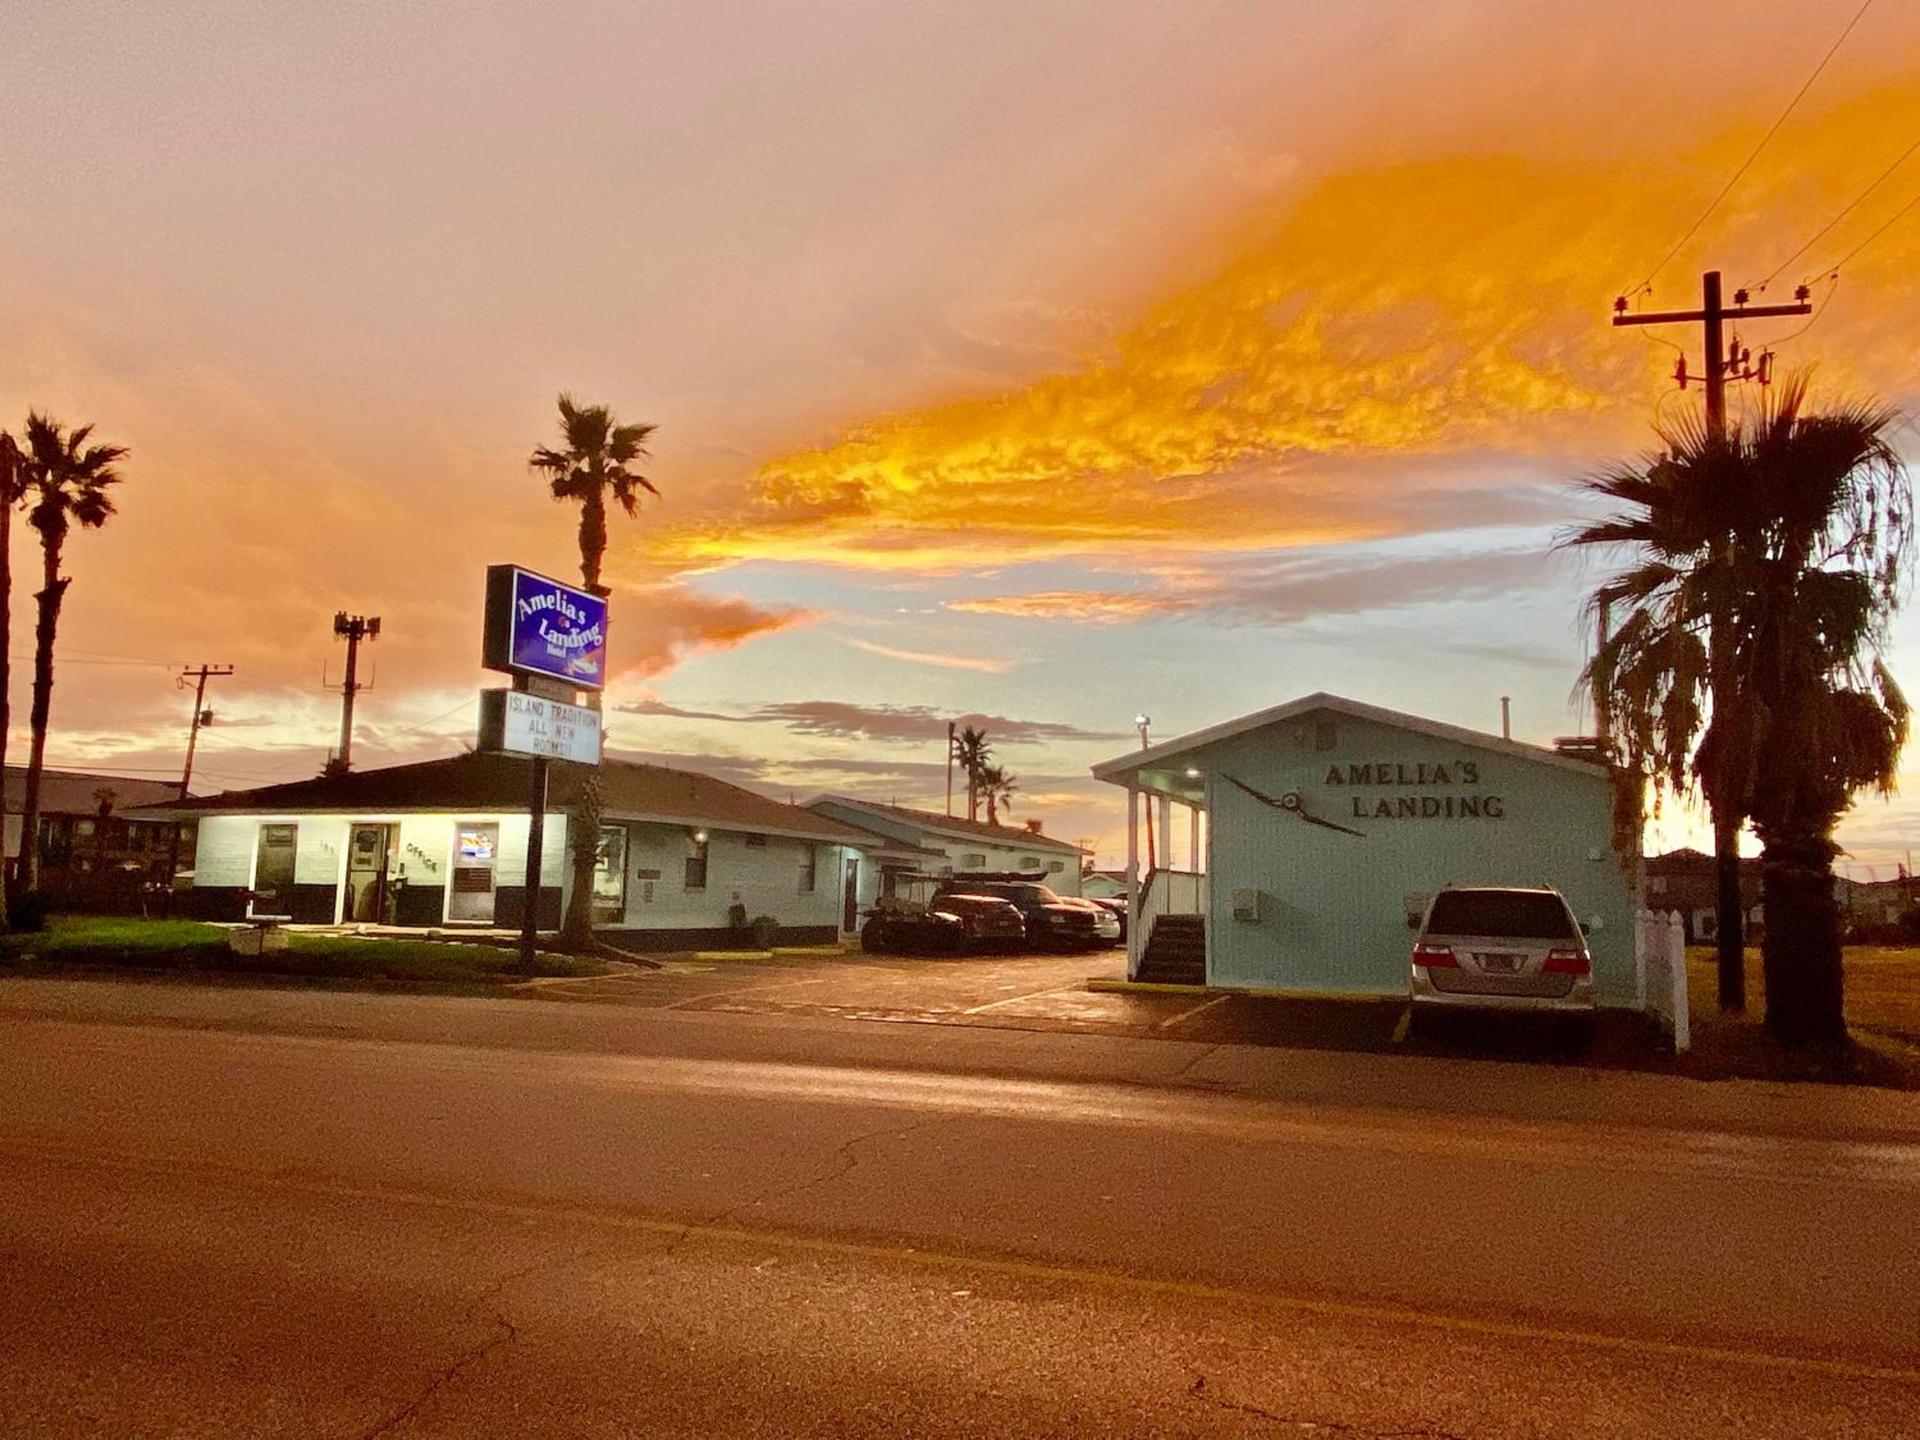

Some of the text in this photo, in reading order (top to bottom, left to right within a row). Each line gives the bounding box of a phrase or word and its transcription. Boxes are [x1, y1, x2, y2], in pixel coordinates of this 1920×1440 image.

[539, 618, 603, 648] Landing
[510, 696, 597, 728] ISLAND TRADITION
[529, 720, 575, 741] ALL NEW
[1325, 760, 1479, 785] AMELIA'S
[1353, 796, 1505, 818] LANDING
[407, 842, 438, 874] OFFICE
